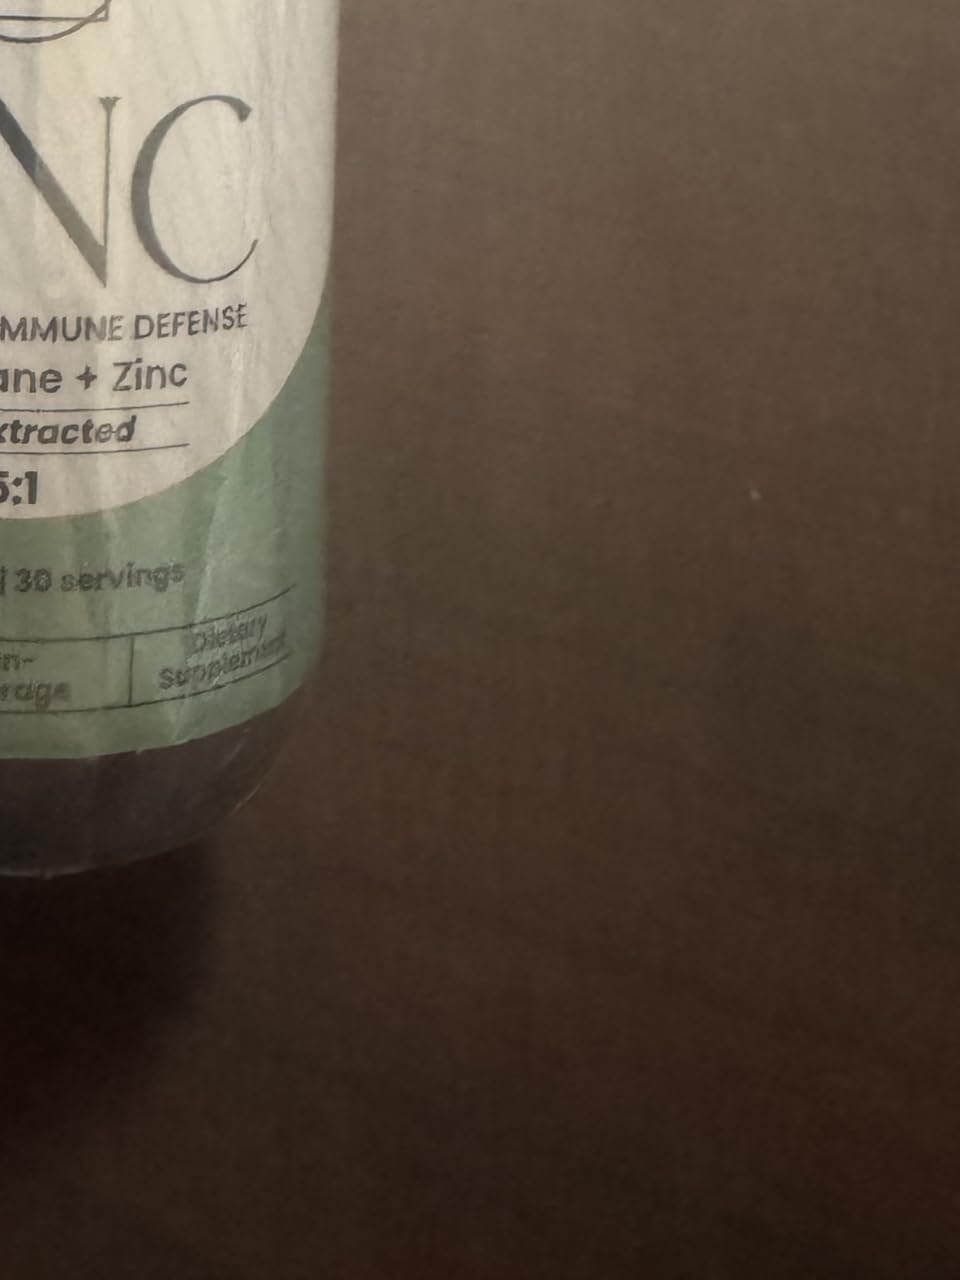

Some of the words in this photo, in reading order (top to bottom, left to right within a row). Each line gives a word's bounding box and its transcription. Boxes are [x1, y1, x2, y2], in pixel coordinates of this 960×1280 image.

[134, 302, 248, 340] DEFENSE
[76, 365, 97, 390] +
[112, 358, 188, 391] Zinc
[14, 568, 52, 592] 30
[60, 562, 184, 592] servings
